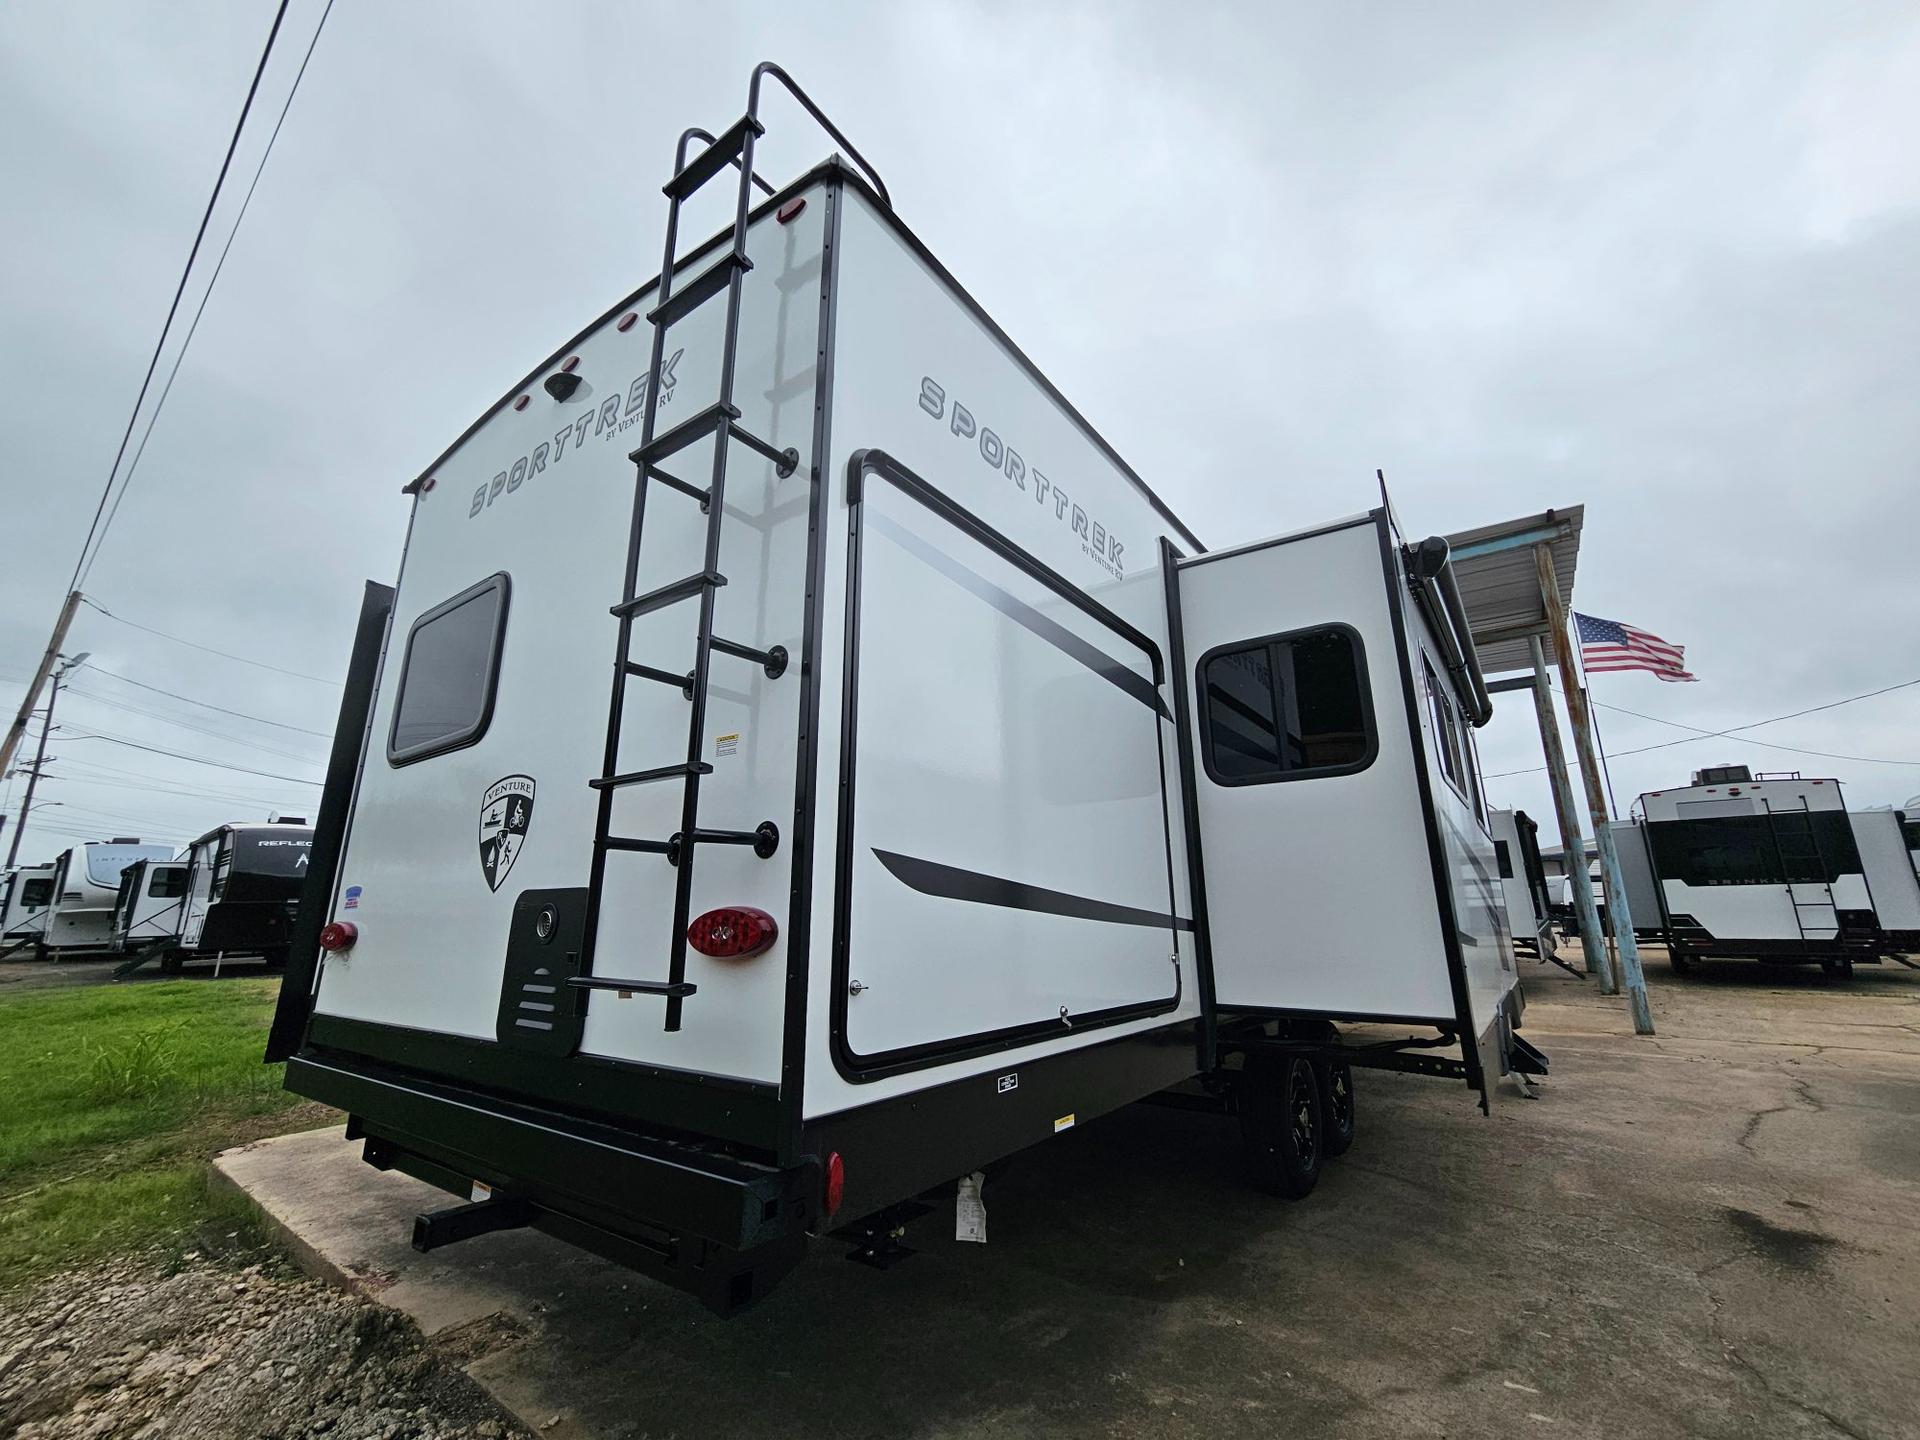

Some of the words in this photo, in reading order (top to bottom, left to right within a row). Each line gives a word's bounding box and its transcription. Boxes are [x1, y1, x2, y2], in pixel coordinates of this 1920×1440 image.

[469, 348, 685, 519] SPORTTREK
[605, 427, 617, 441] BY
[658, 388, 675, 408] RV
[918, 376, 1125, 570] SPORTTREK
[488, 781, 531, 800] VENTURE
